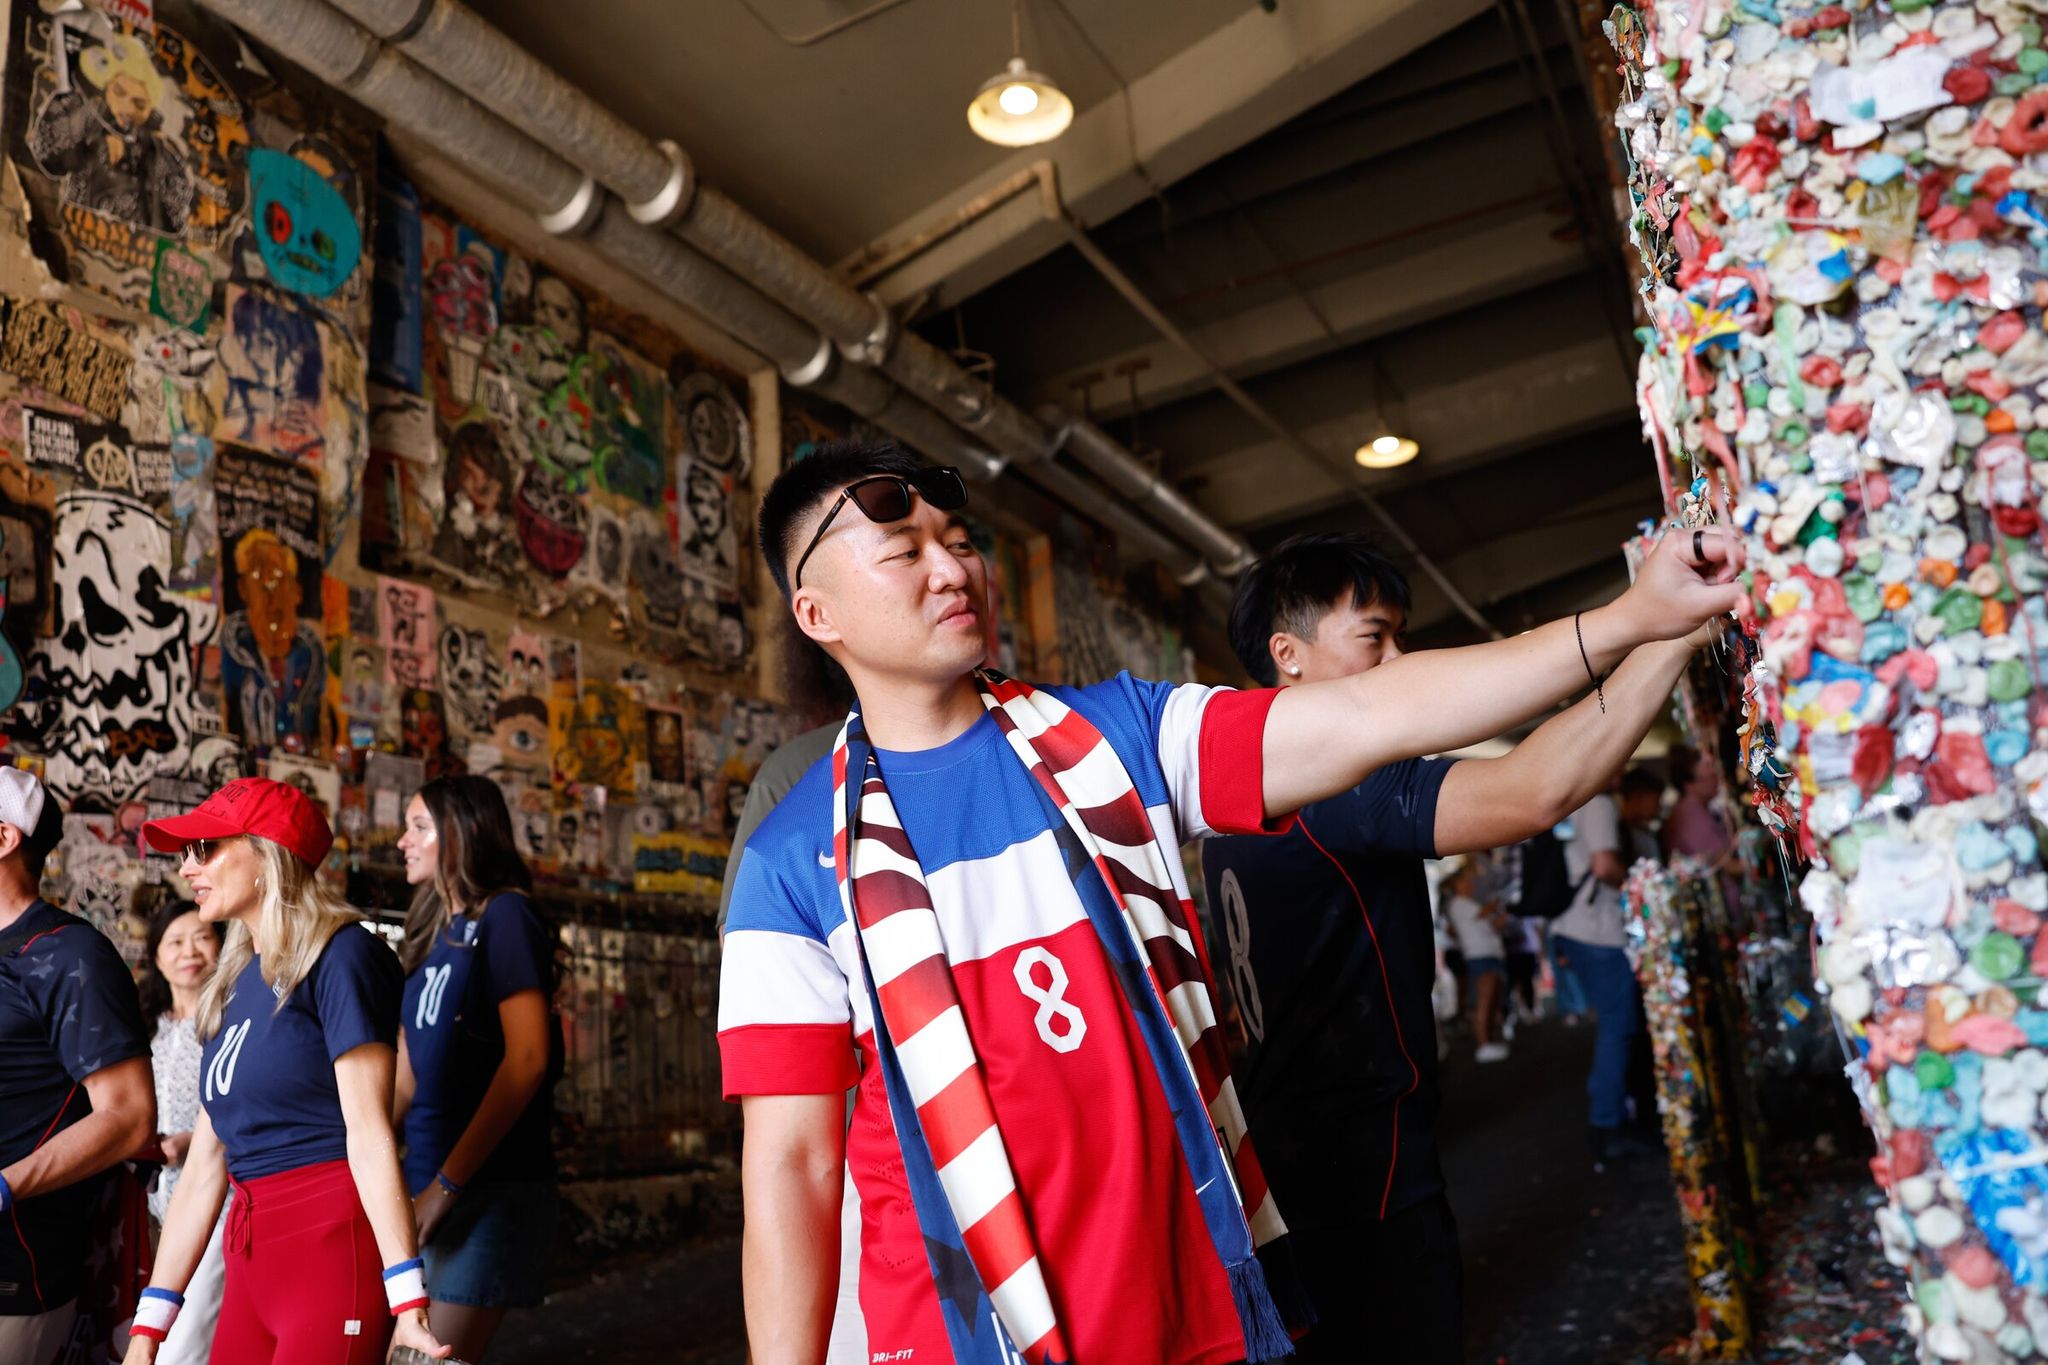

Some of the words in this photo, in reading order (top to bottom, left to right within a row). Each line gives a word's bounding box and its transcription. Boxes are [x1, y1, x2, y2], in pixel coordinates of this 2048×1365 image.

[415, 963, 452, 1030] 10
[1220, 867, 1265, 1045] 8
[1012, 945, 1087, 1054] 8
[205, 1018, 251, 1102] 10
[872, 1348, 914, 1363] DRI-FIT
